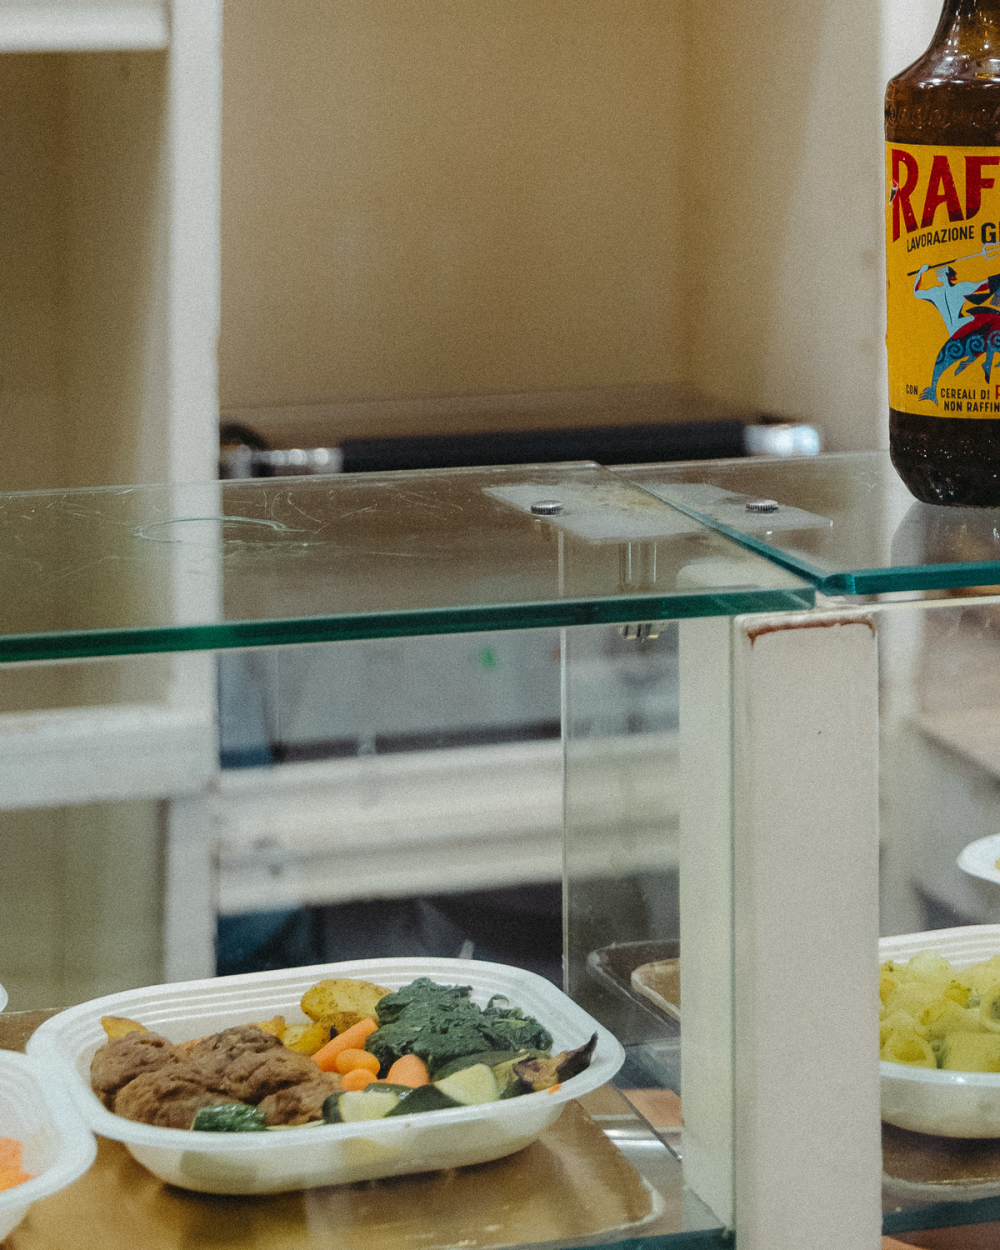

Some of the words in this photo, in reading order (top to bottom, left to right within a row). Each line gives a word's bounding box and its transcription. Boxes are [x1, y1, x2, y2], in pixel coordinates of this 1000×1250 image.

[907, 225, 975, 253] LAVORAZIONE
[906, 384, 919, 396] CON
[940, 388, 976, 400] CEREALI
[980, 389, 991, 400] DI
[944, 400, 963, 412] NON
